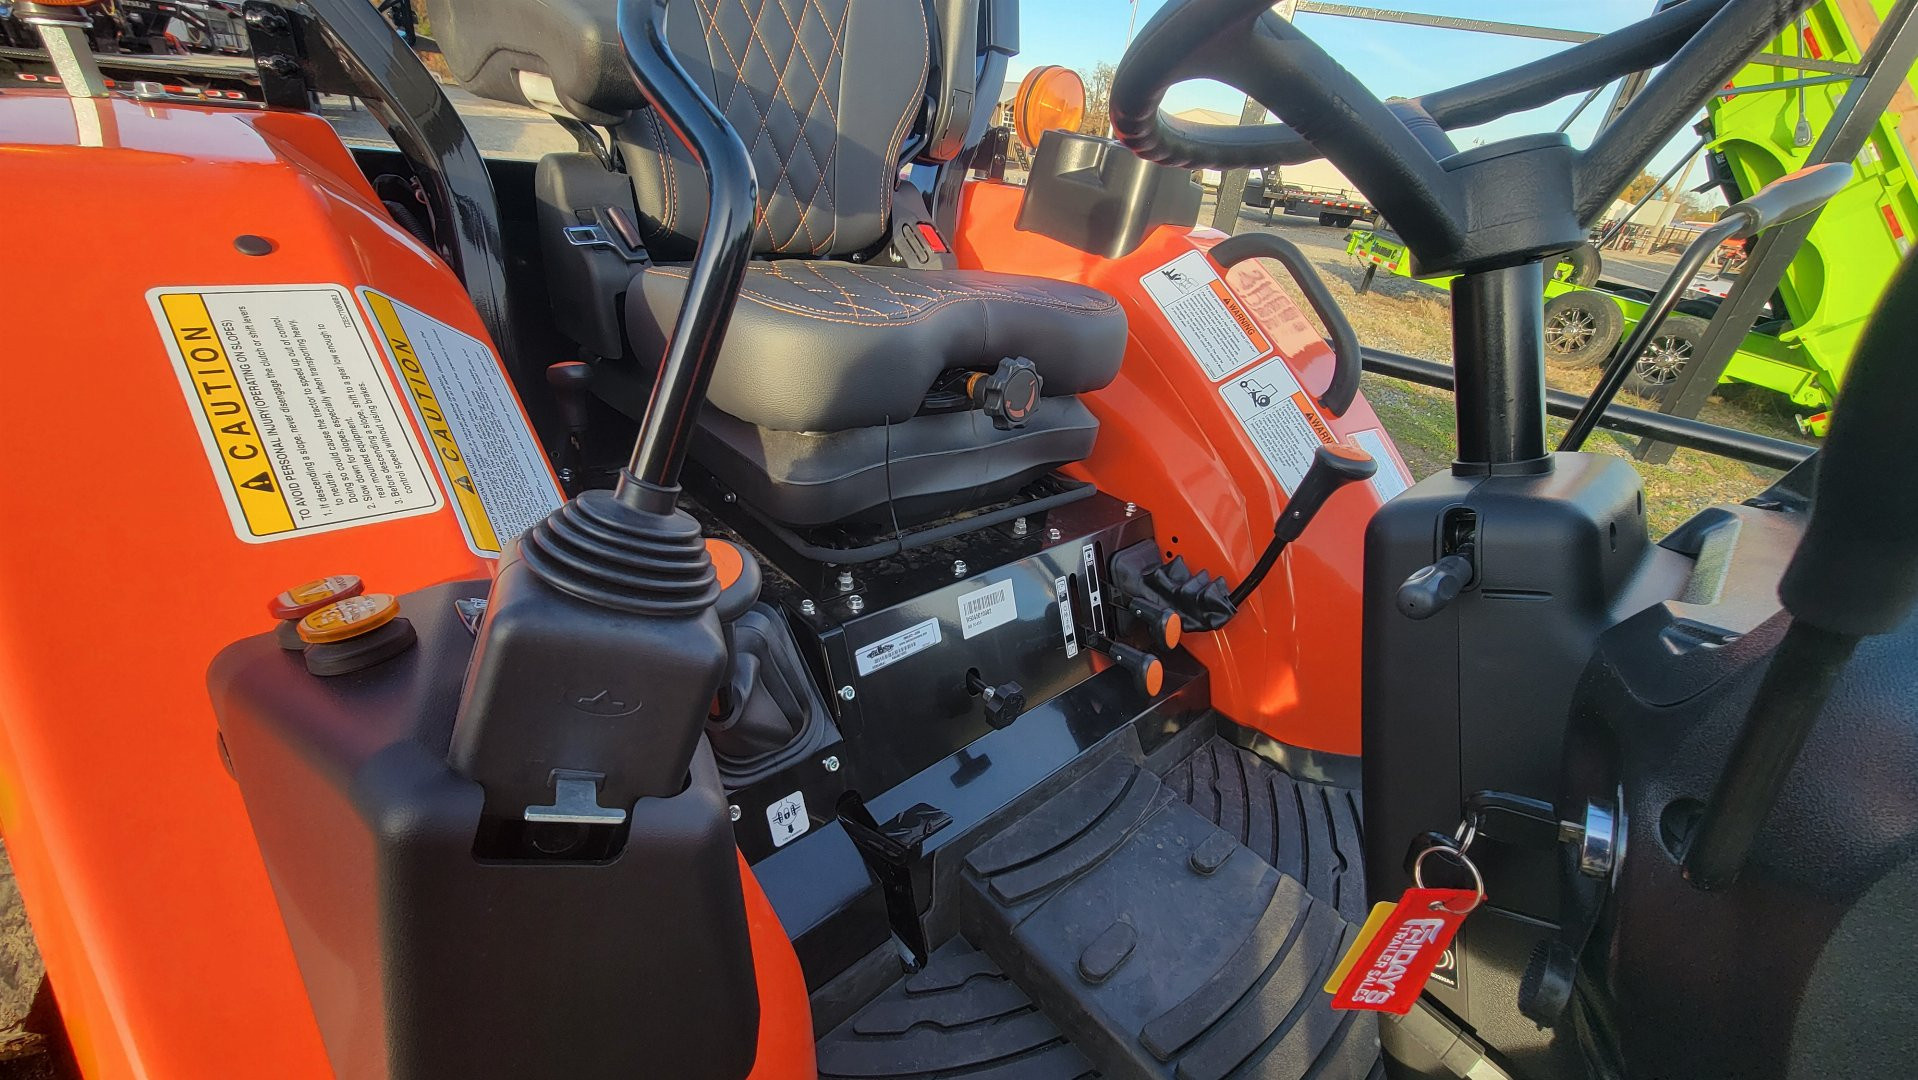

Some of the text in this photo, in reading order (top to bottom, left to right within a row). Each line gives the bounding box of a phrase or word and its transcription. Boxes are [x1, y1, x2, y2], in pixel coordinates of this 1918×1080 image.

[238, 305, 252, 324] levers
[1229, 303, 1256, 336] WARNING
[220, 319, 243, 350] SLOPES)
[244, 324, 259, 339] shift
[269, 315, 288, 338] control.
[284, 346, 296, 357] out
[319, 330, 337, 353] enough
[255, 347, 271, 367] clutch
[296, 338, 319, 377] transporting
[331, 354, 342, 365] low
[264, 367, 276, 379] the
[292, 367, 310, 387] speed
[336, 366, 351, 380] gear
[180, 327, 258, 460] CAUTION
[270, 379, 290, 413] disengage
[313, 377, 327, 395] when
[306, 396, 322, 418] tractor
[320, 395, 341, 428] especially
[347, 394, 361, 408] shift
[389, 337, 460, 463] CAUTION
[284, 414, 299, 433] never
[316, 418, 327, 430] the
[1310, 416, 1334, 445] WARN
[322, 430, 336, 451] cause
[336, 428, 352, 453] slopes,
[358, 381, 413, 494] control speed without using brakes.
[270, 437, 296, 481] PERSONAL
[328, 451, 345, 471] could
[344, 416, 386, 499] rear mounted equipment.
[346, 453, 357, 464] for
[367, 435, 390, 473] descending
[304, 461, 327, 502] descending
[351, 464, 365, 483] down
[288, 482, 307, 506] AVOID
[344, 482, 359, 504] Doing
[359, 484, 373, 502] Slow
[385, 474, 400, 497] Before
[475, 479, 494, 514] PERSONAL
[491, 516, 503, 536] AVOID
[1351, 925, 1412, 1002] TRAILER SALES
[1364, 918, 1445, 1004] FRIDAY'S
